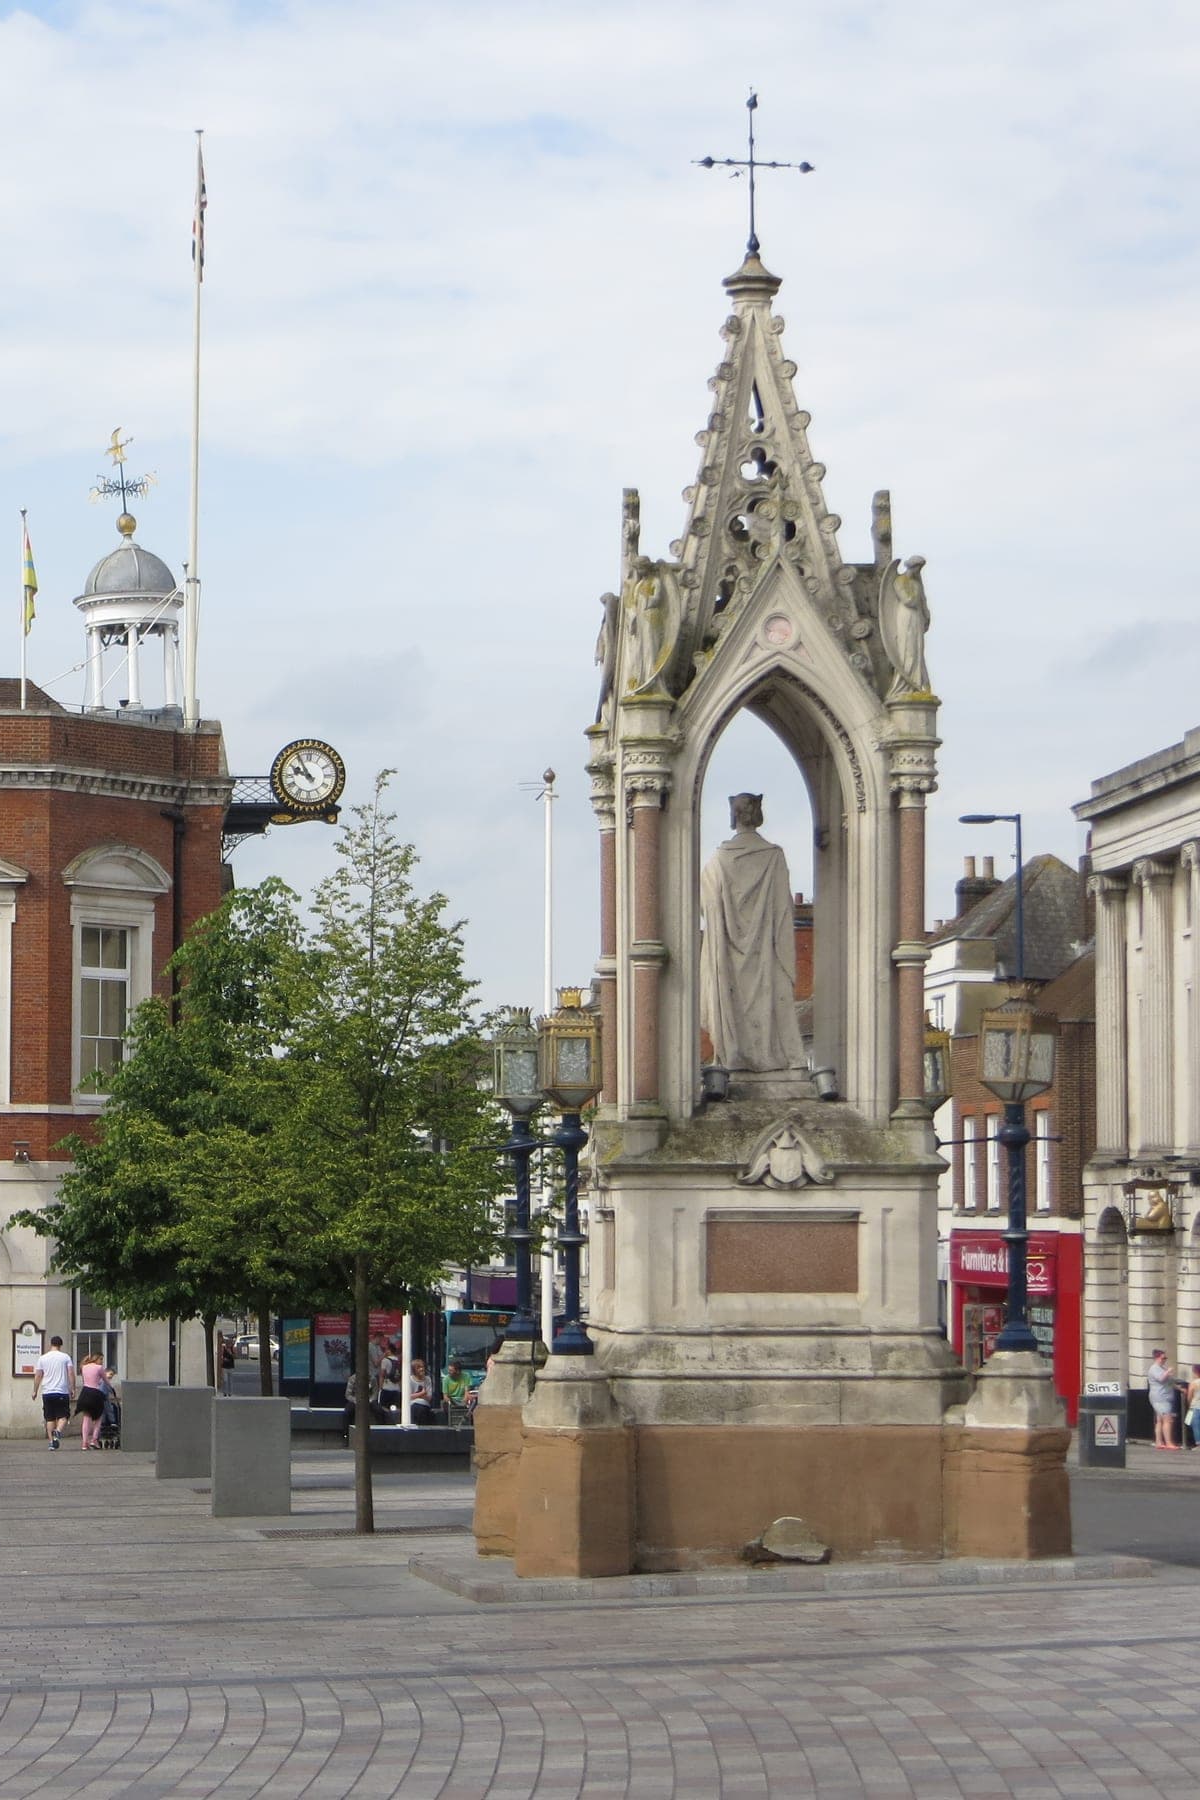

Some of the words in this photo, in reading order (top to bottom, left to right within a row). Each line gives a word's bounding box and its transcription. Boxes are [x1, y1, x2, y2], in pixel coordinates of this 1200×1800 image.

[960, 1245, 997, 1273] Furniture
[997, 1247, 1005, 1273] &
[1087, 1383, 1110, 1393] Sim
[1111, 1383, 1120, 1393] 3
